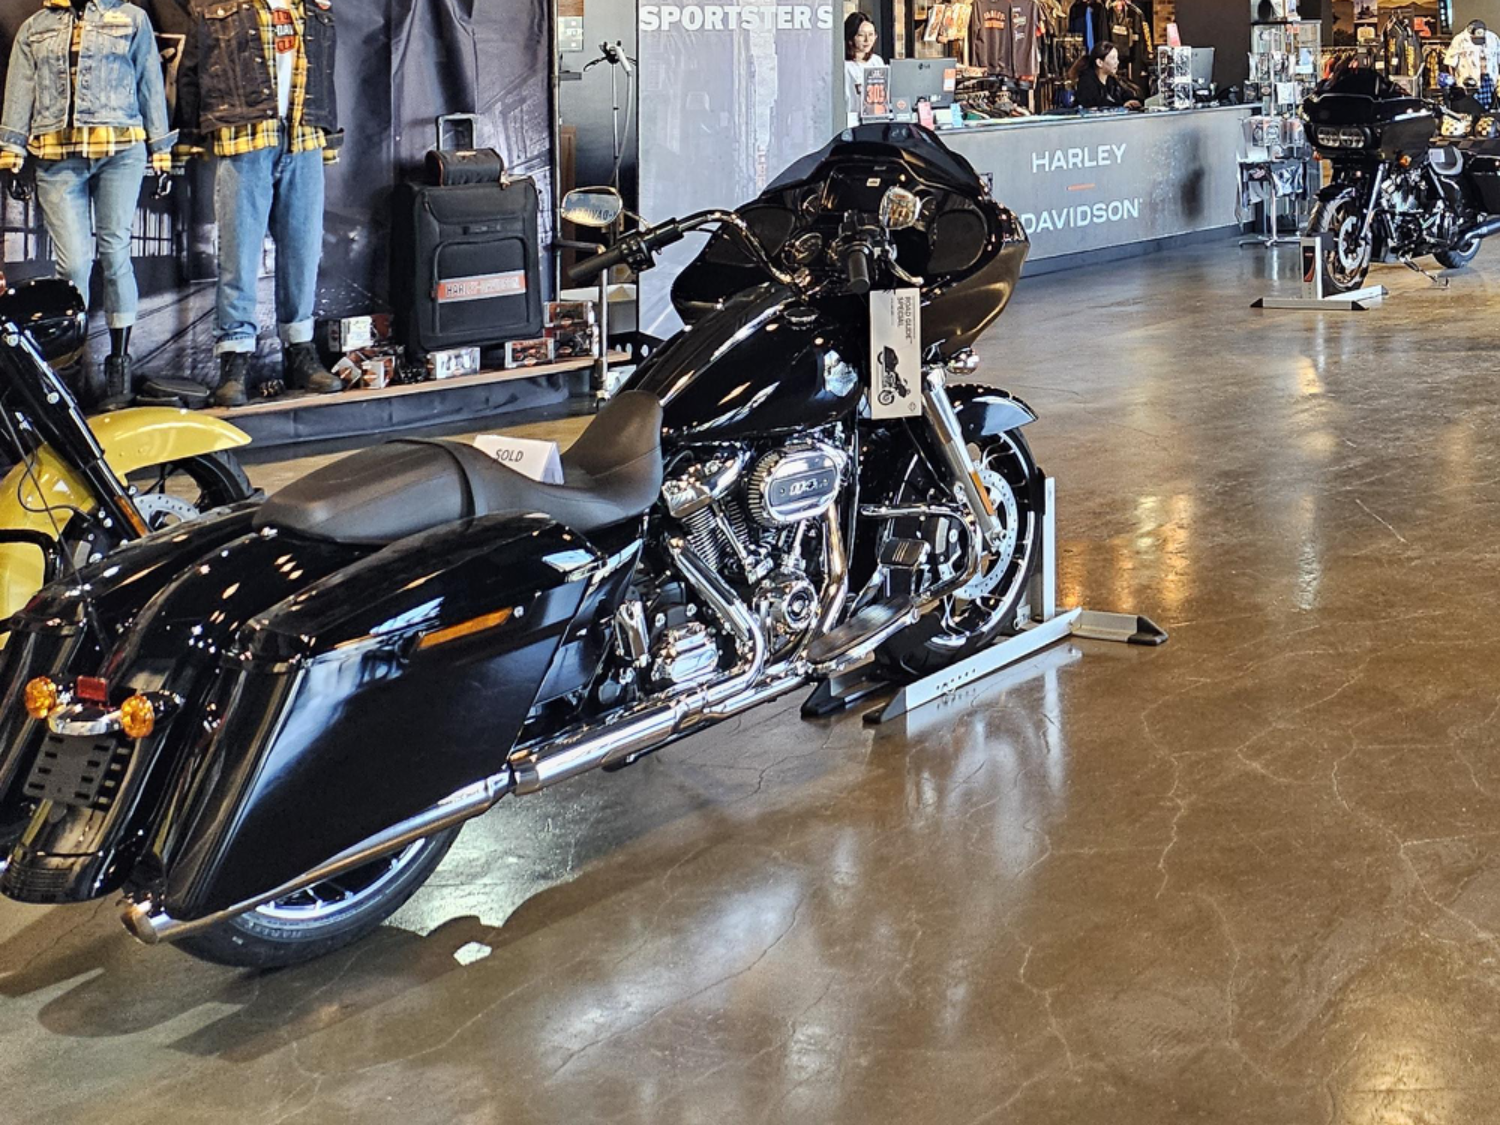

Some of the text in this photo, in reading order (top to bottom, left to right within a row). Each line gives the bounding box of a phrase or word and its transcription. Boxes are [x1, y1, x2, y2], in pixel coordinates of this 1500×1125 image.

[639, 5, 833, 32] SPORTSTER S
[1031, 143, 1127, 173] HARLEY
[1020, 198, 1140, 235] DAVIDSON
[495, 448, 525, 463] SOLD
